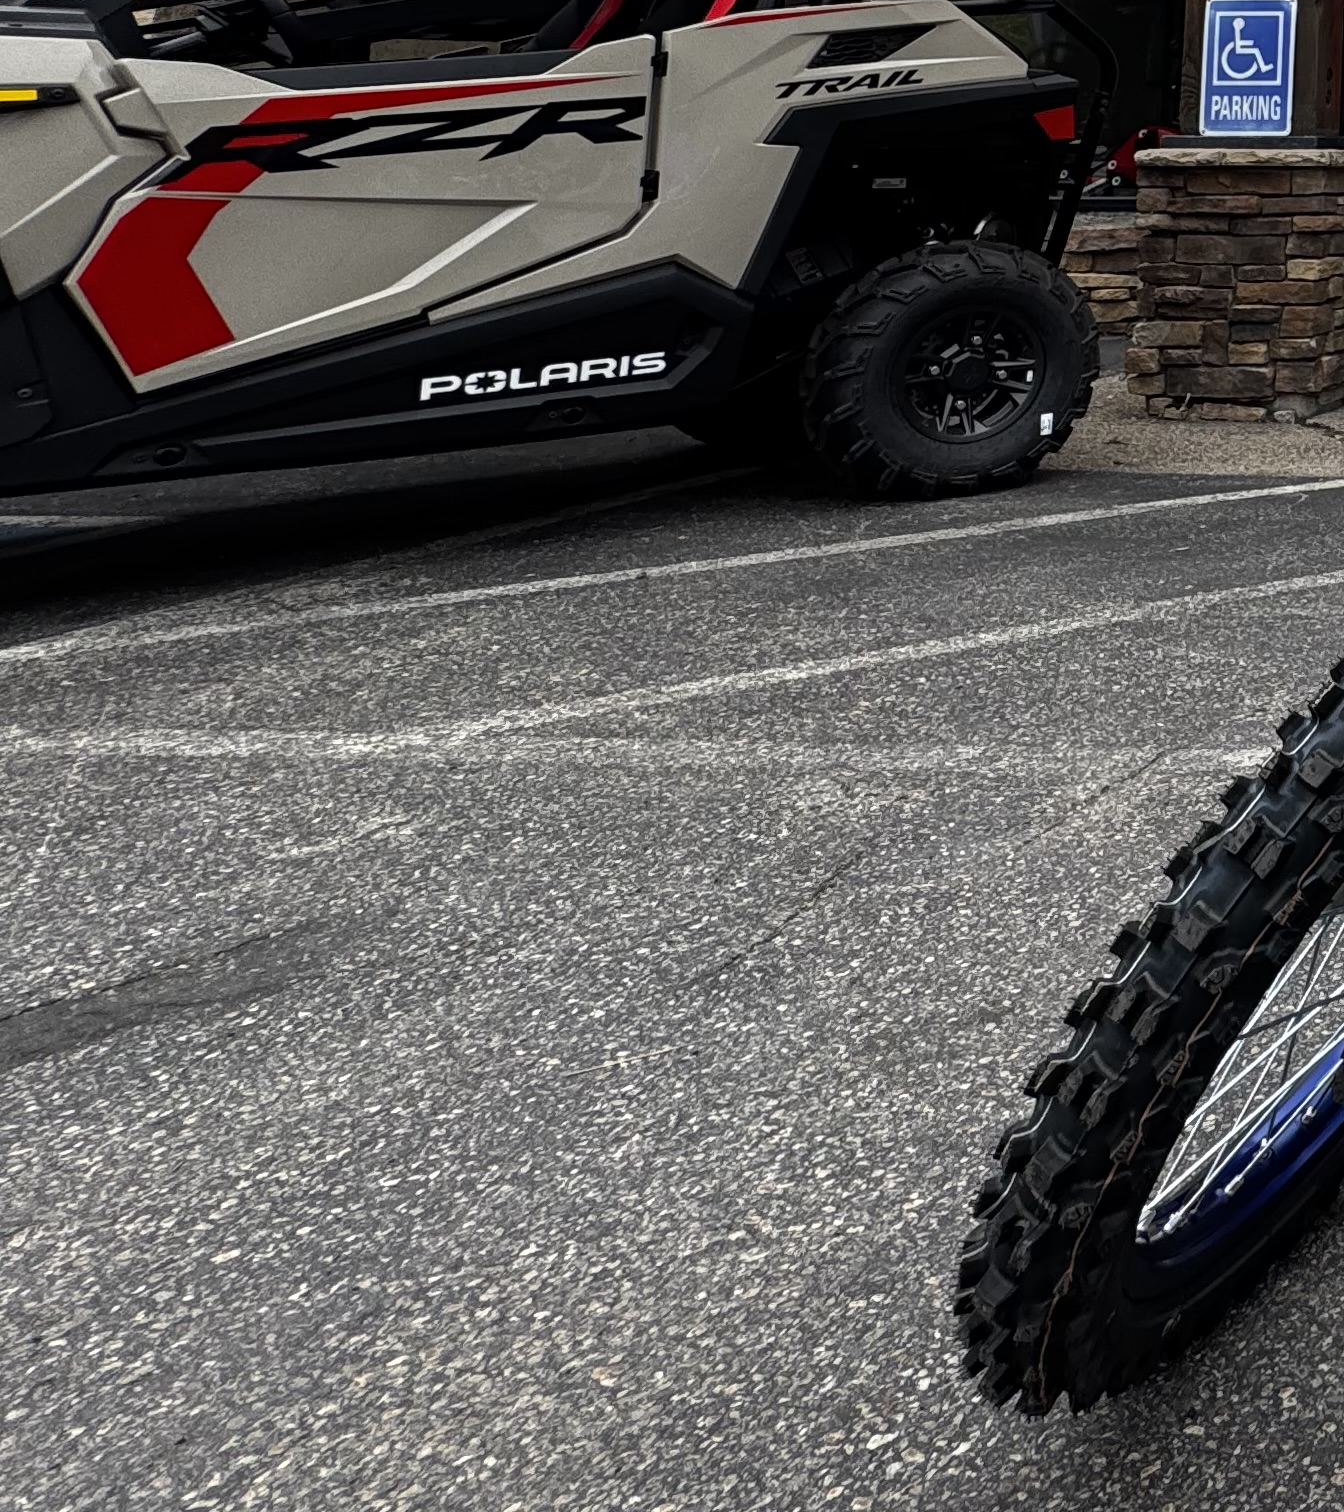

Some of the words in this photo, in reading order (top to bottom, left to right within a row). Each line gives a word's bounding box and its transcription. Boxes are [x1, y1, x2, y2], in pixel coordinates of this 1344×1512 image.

[775, 69, 925, 99] TRAIL
[1210, 94, 1281, 122] PARKING
[136, 95, 647, 191] RZR
[419, 352, 666, 401] POLARIS
